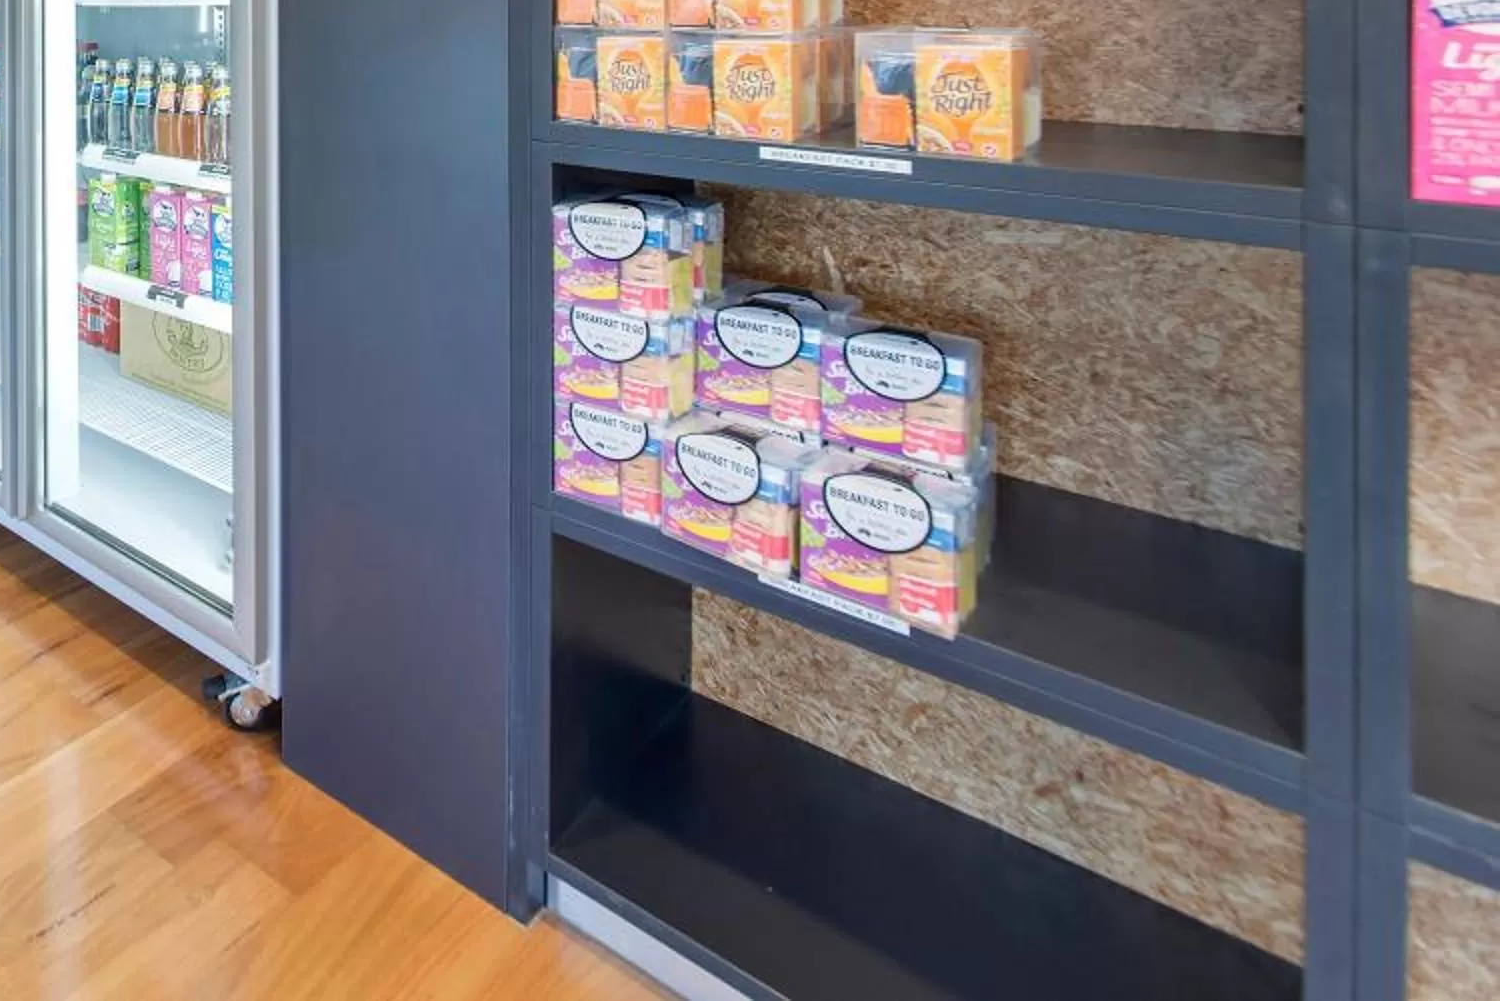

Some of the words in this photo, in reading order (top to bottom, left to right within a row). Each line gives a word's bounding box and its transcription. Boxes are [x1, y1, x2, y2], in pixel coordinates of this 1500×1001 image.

[931, 72, 987, 93] Just
[931, 91, 992, 117] Right
[850, 344, 908, 365] BREAKFAST
[681, 442, 729, 469] BREAKFAST
[830, 486, 889, 513] BREAKFAST
[909, 509, 925, 522] GO
